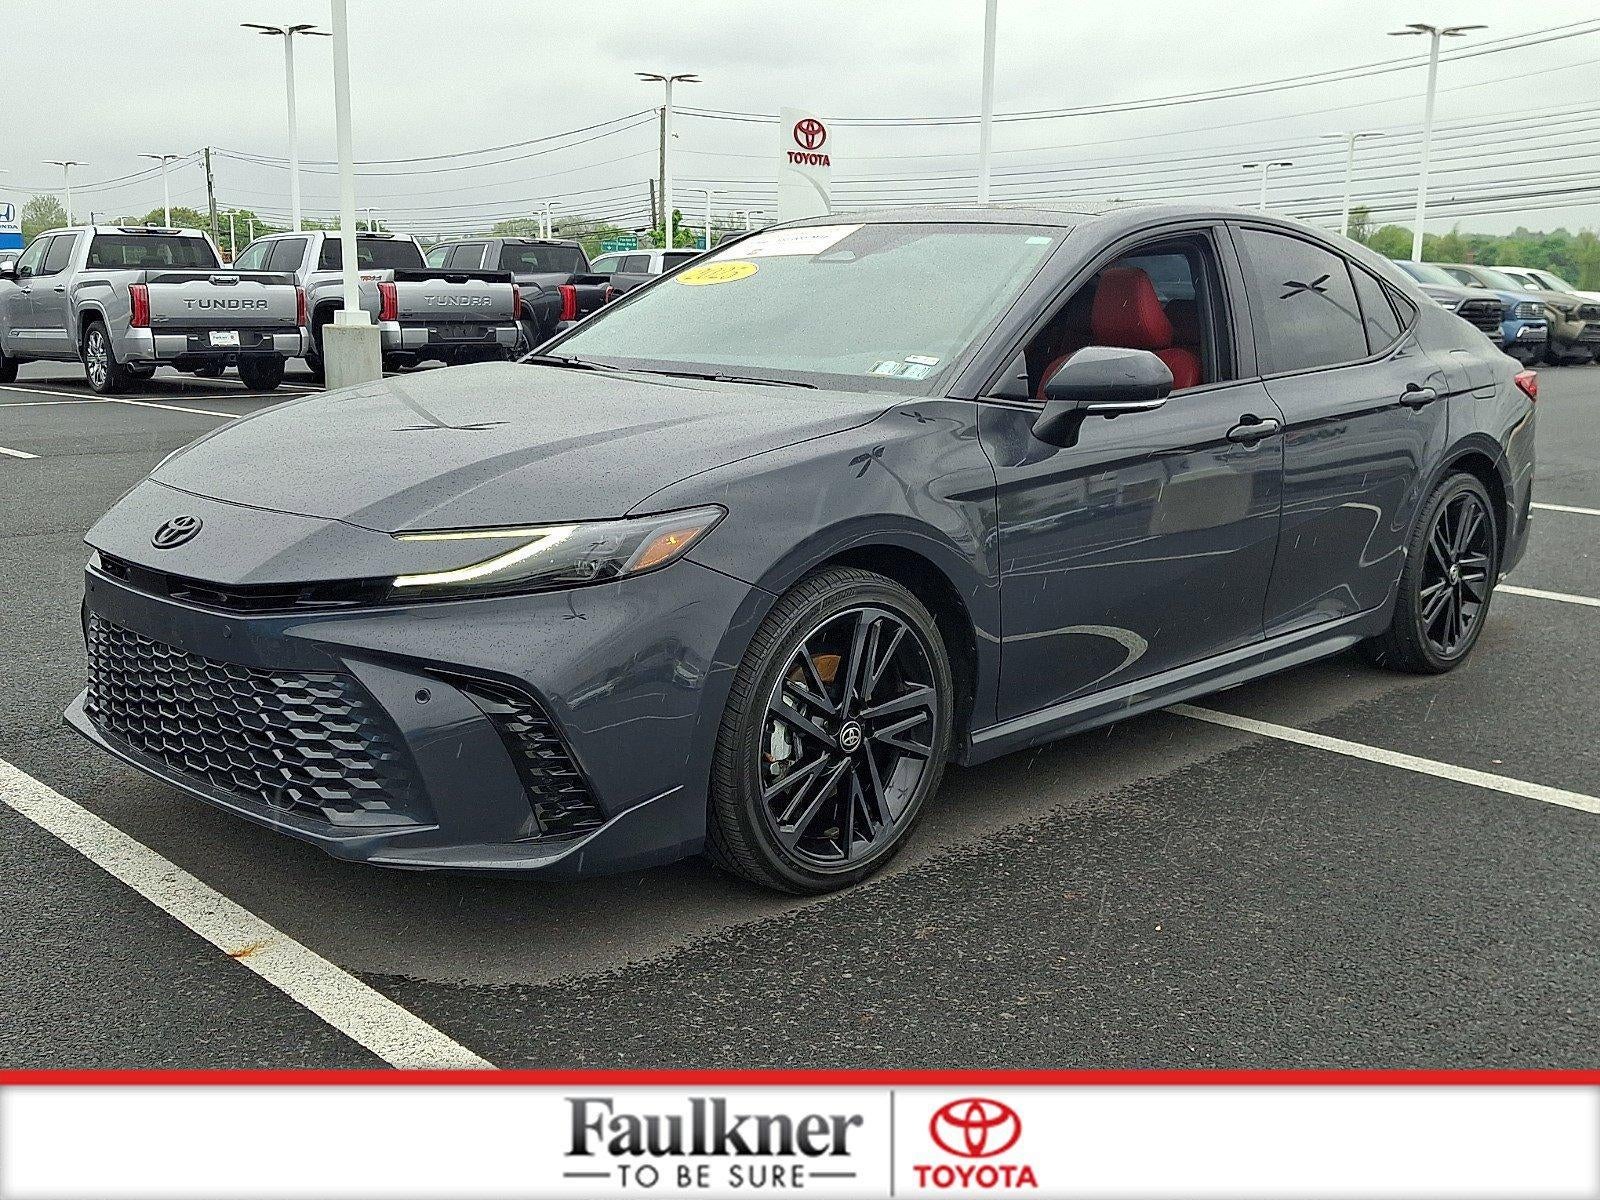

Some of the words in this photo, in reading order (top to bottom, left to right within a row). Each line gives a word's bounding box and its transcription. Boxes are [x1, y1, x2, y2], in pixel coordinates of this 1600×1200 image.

[787, 151, 830, 167] TOYOTA
[183, 298, 269, 311] TUNDRA
[424, 295, 492, 306] TUNDRA
